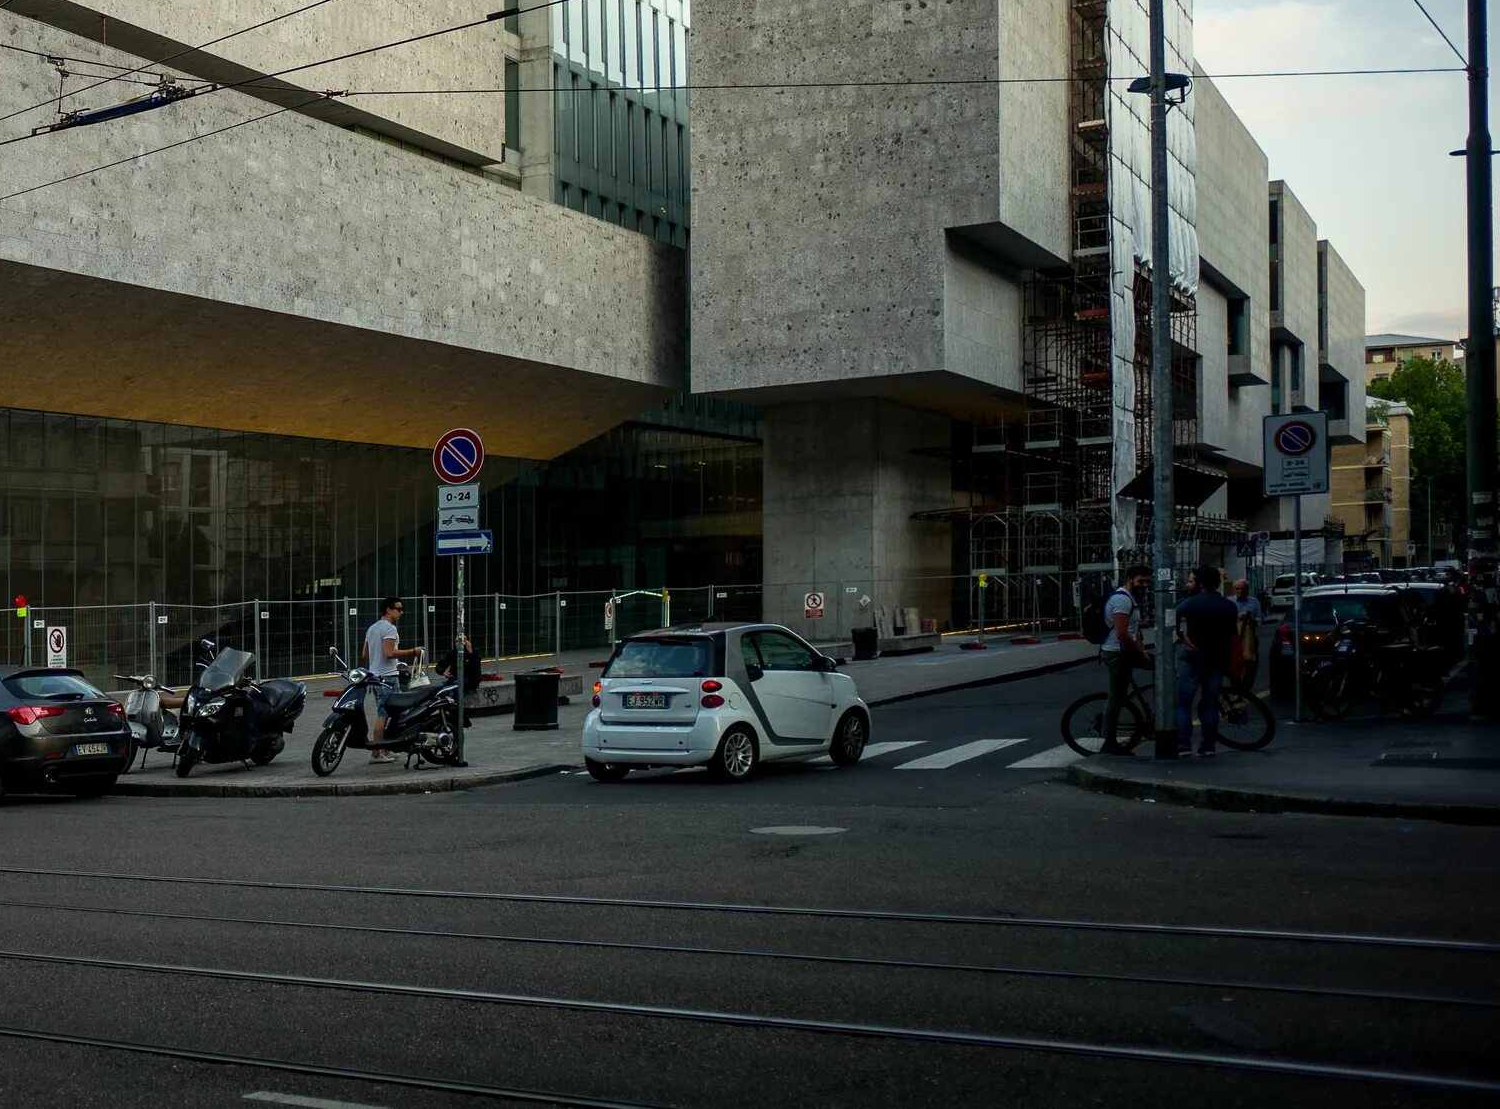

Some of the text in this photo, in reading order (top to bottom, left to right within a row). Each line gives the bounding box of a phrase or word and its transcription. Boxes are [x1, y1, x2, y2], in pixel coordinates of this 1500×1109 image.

[446, 492, 470, 501] 0-24
[627, 696, 664, 706] EJ 952WR
